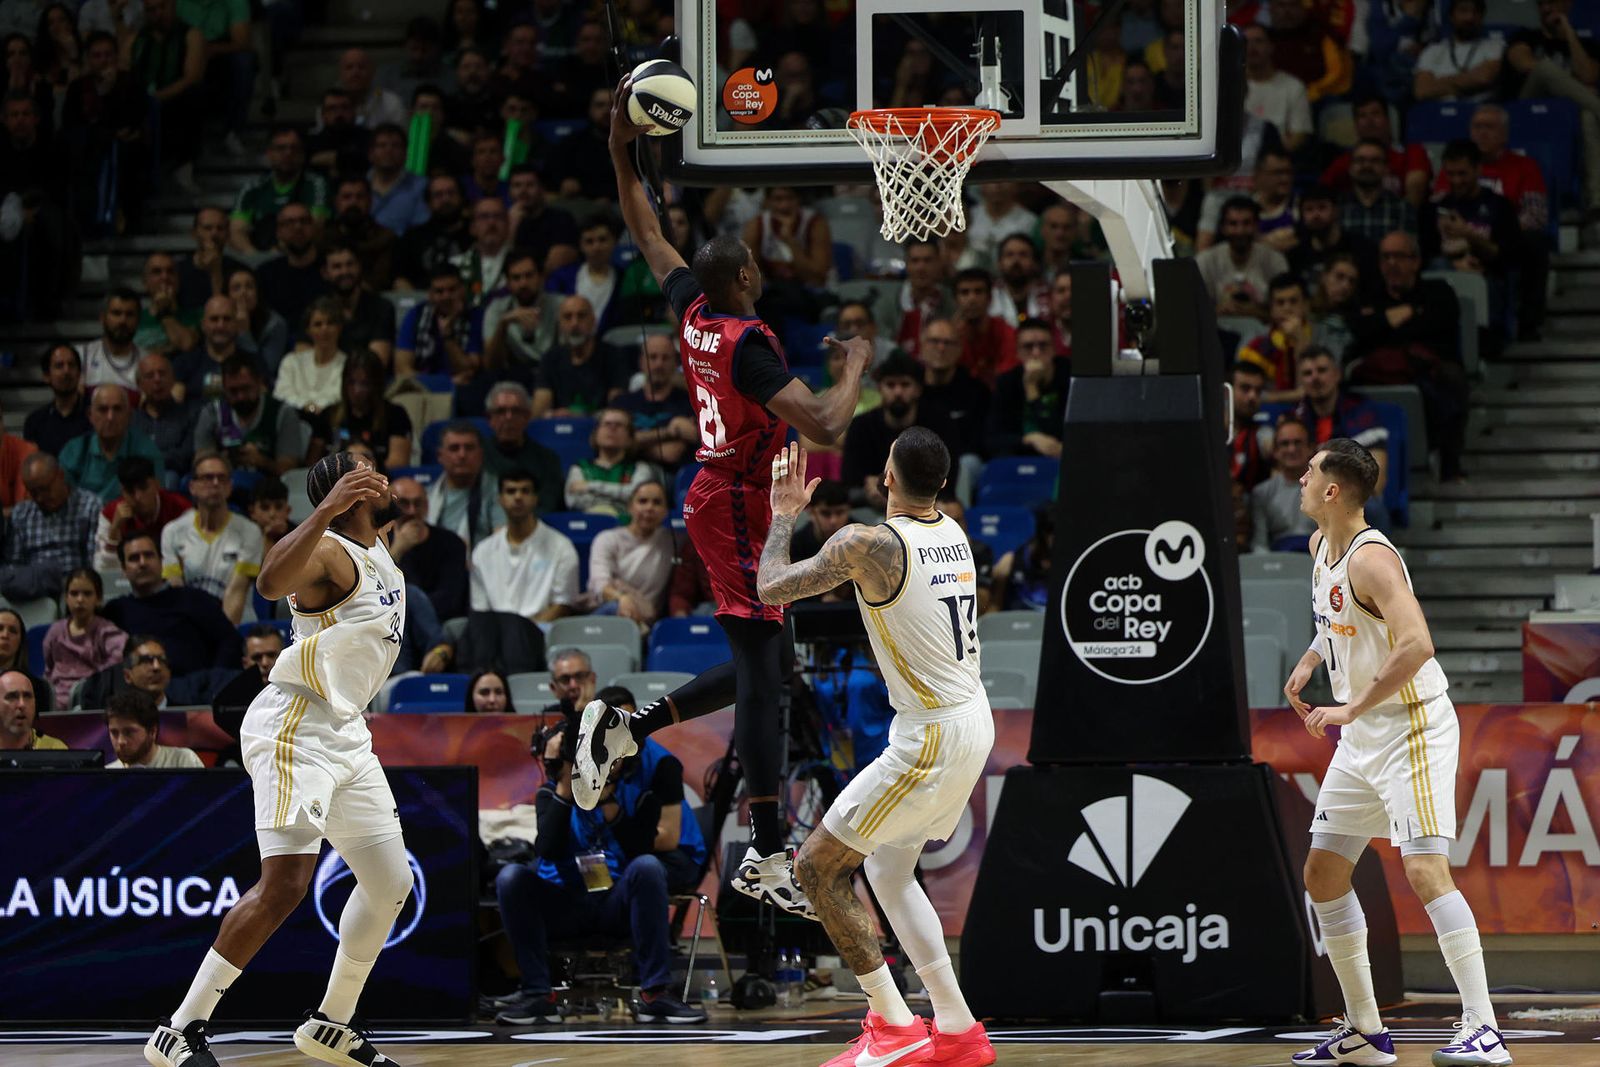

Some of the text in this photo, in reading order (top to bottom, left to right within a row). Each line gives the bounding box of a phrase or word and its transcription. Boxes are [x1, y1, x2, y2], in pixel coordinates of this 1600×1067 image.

[732, 90, 760, 100] Copa
[745, 100, 764, 110] Rey
[696, 385, 727, 448] 21
[918, 543, 971, 565] POIRIER
[1104, 574, 1143, 590] acb
[1089, 591, 1162, 616] Copa
[1093, 616, 1172, 643] del Rey
[0, 866, 240, 917] A MÚSICA
[1033, 903, 1229, 964] Unicaja
